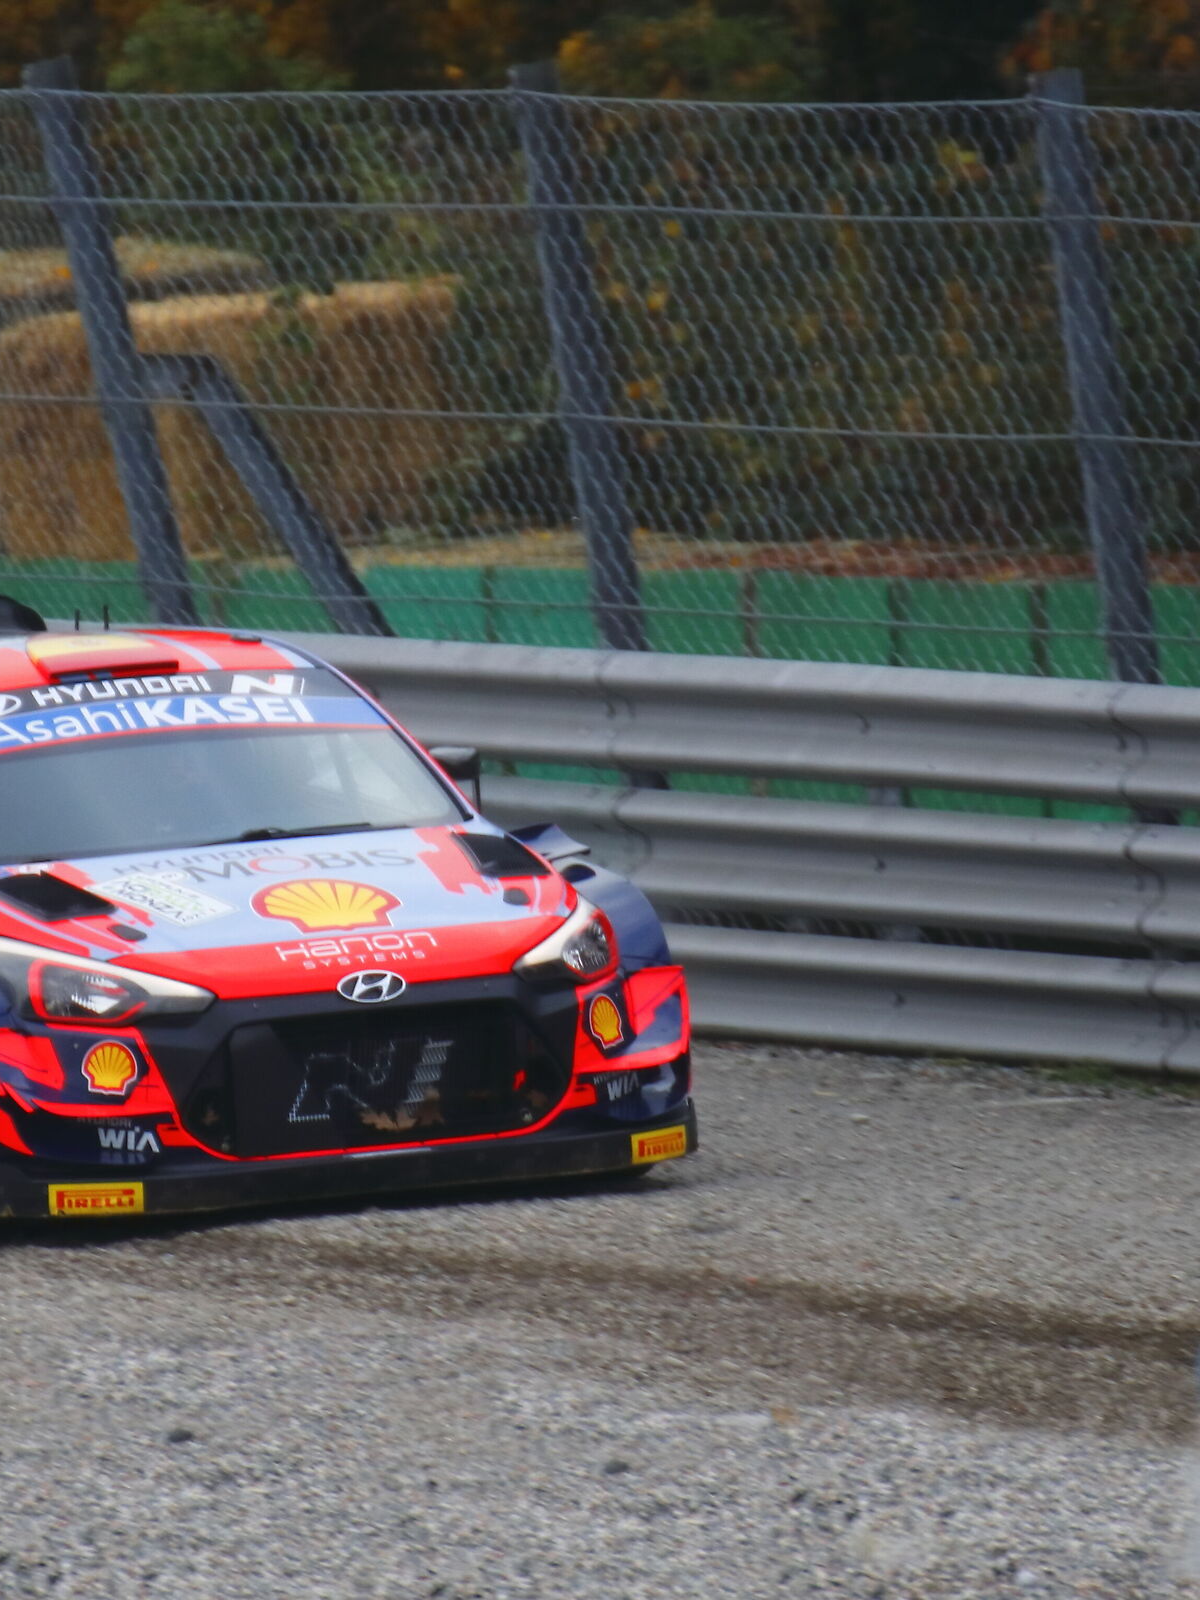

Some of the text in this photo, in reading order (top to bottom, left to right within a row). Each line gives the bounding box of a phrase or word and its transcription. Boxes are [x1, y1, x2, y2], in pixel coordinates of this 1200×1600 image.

[30, 674, 212, 707] HYUNDAI
[112, 845, 285, 876] HYUNDAI
[182, 847, 416, 883] MOBIS
[303, 949, 426, 970] SYSTEMS
[56, 1188, 135, 1209] PIRELLI
